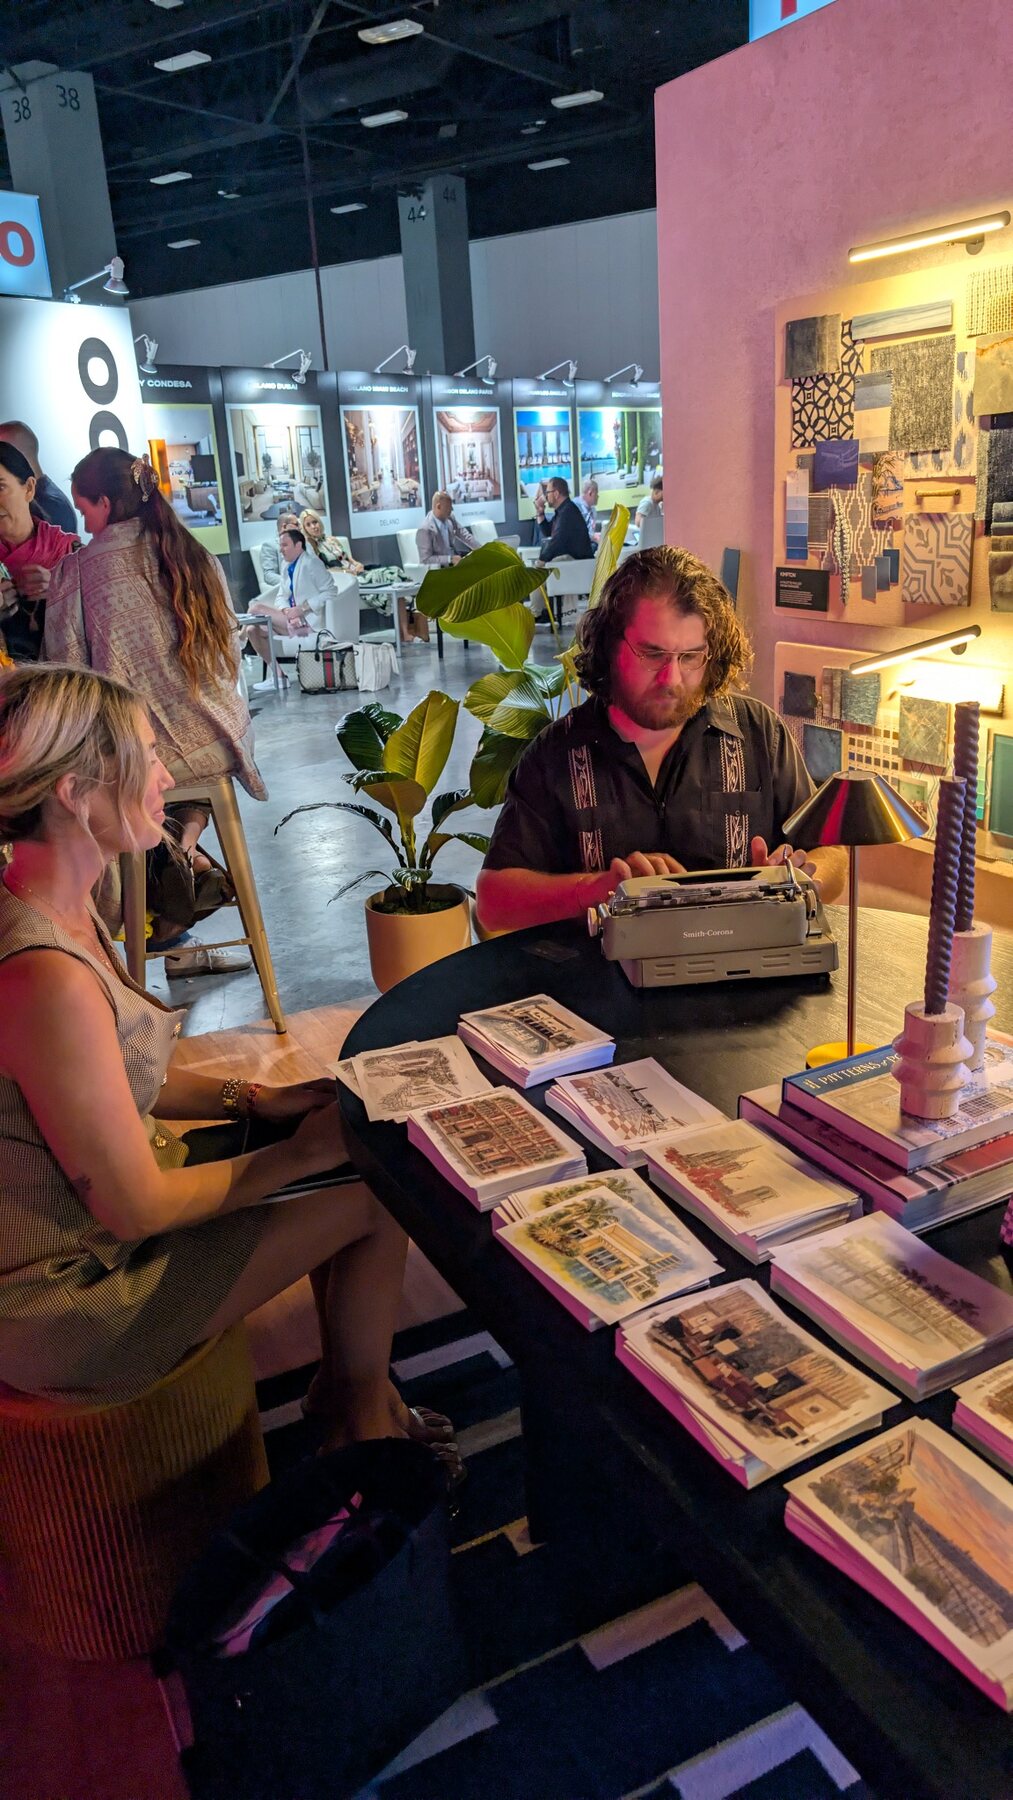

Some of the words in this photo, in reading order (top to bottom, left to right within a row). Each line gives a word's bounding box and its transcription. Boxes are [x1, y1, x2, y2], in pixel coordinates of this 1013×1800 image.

[56, 84, 81, 111] 38
[12, 96, 32, 123] 38
[146, 380, 192, 388] CONDESA
[379, 518, 400, 527] DELANO
[682, 929, 734, 939] Smith-Corona
[818, 1061, 881, 1085] PATTERNS
